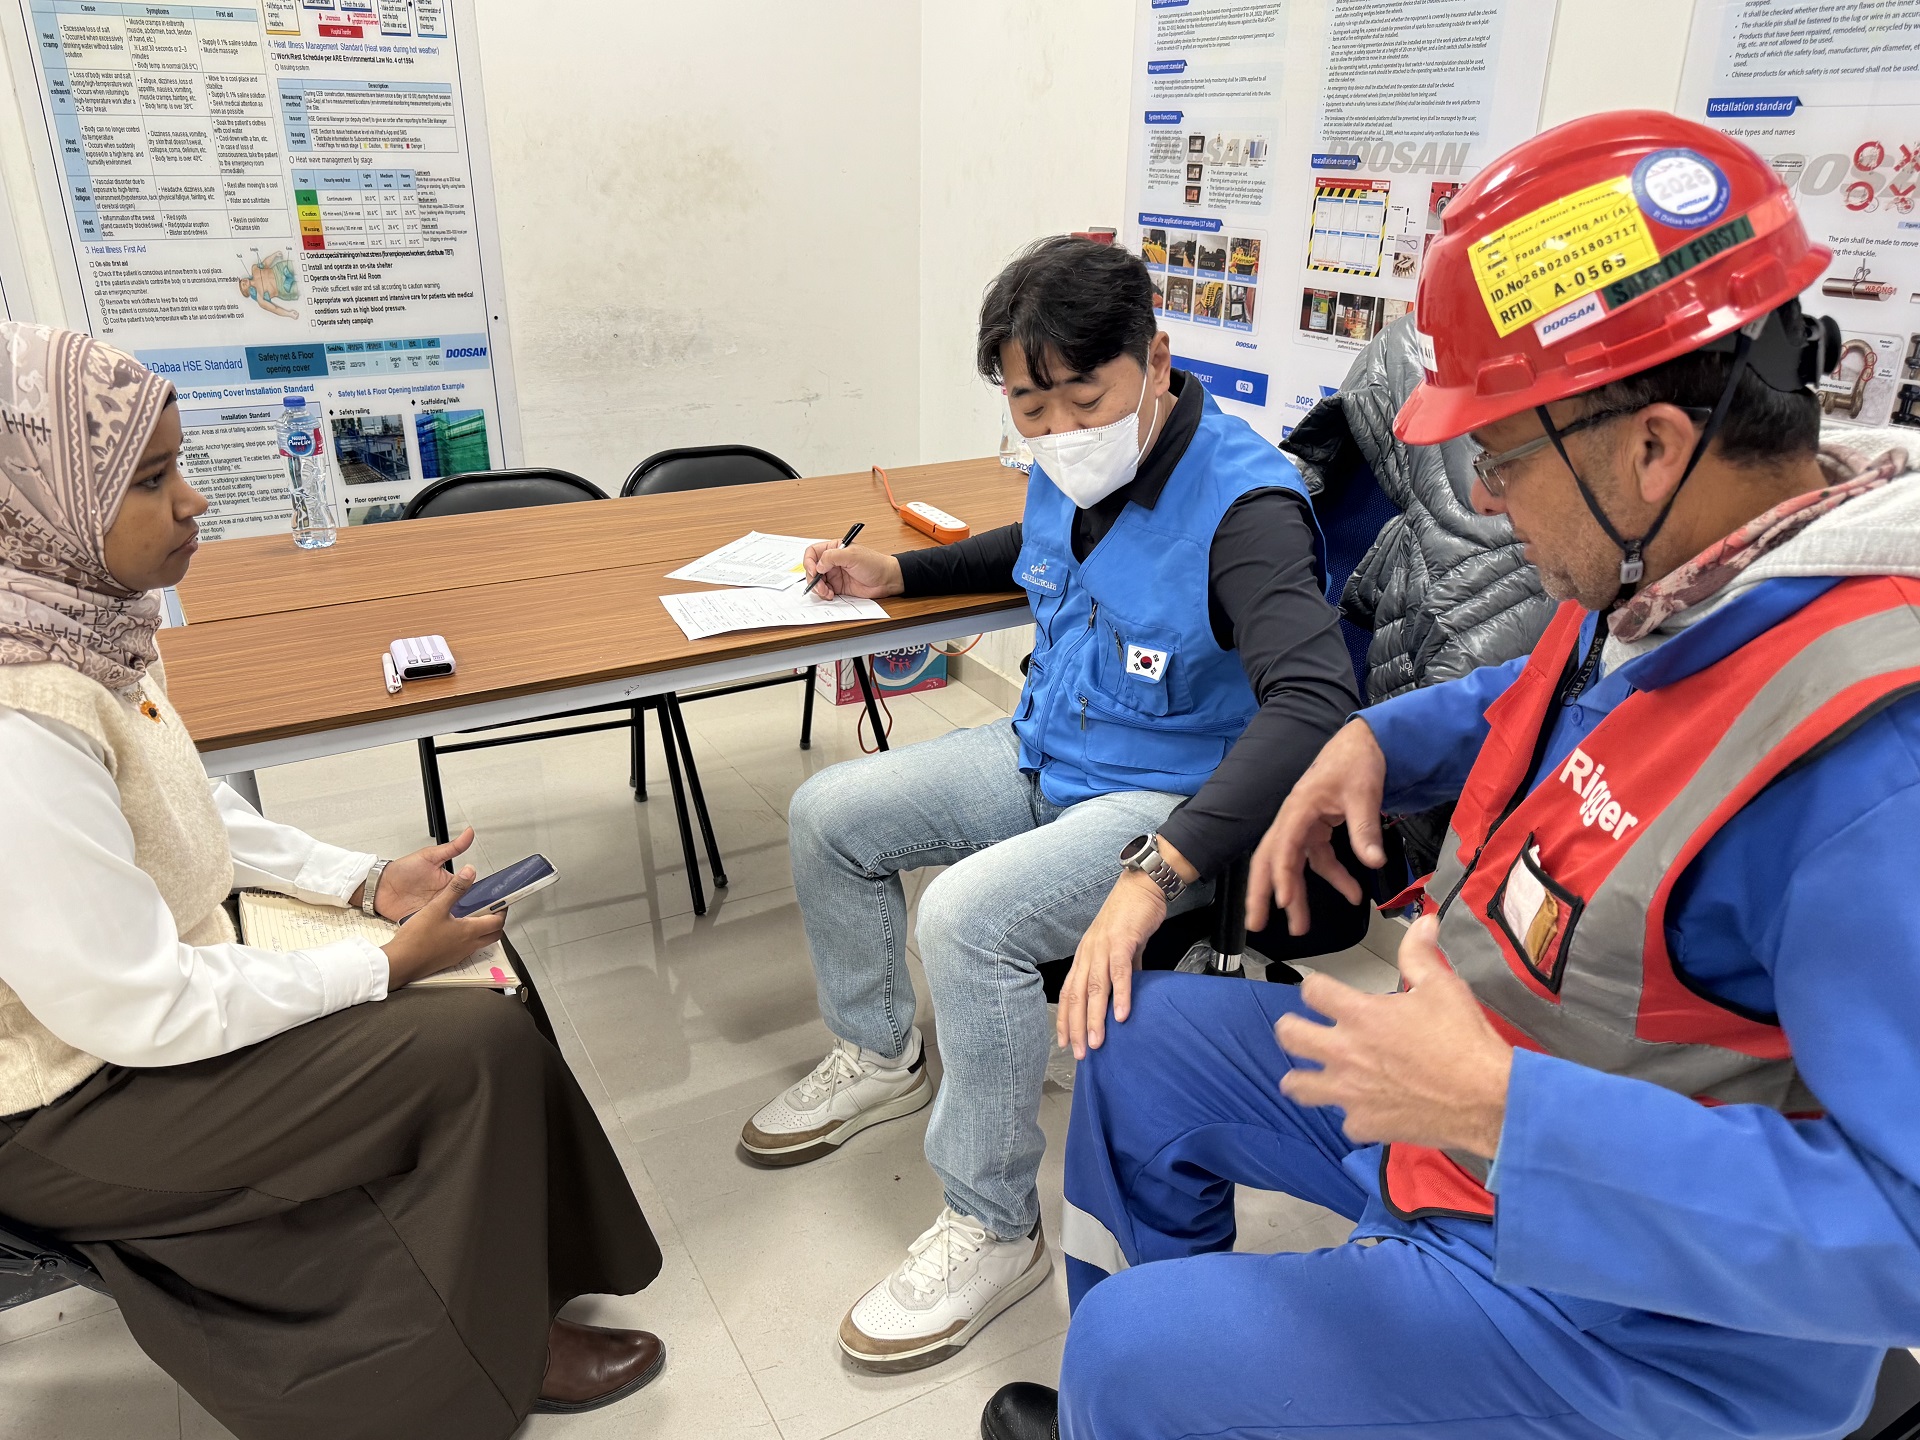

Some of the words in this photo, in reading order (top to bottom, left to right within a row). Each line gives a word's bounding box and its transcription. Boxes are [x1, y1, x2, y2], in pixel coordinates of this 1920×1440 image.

[80, 4, 96, 12] Cause
[146, 8, 170, 16] Symptoms
[1747, 10, 1761, 18] shall
[1769, 7, 1793, 16] checked
[1793, 5, 1818, 14] whether
[1818, 4, 1835, 13] there
[1845, 4, 1858, 12] any
[1858, 1, 1875, 10] flaws
[1884, 0, 1896, 8] the
[43, 41, 59, 49] cramp
[1731, 70, 1752, 78] Chinese
[1752, 69, 1777, 79] products
[1786, 68, 1804, 76] which
[1804, 67, 1823, 77] safety
[1840, 66, 1865, 74] secured
[1864, 65, 1880, 73] shall
[1892, 64, 1901, 72] be
[1709, 101, 1754, 112] Installation
[1755, 100, 1792, 111] standard
[1148, 113, 1160, 122] System
[1720, 128, 1743, 136] Shackle
[1743, 128, 1761, 137] types
[1313, 157, 1336, 166] Installation
[1336, 158, 1355, 168] example
[1327, 140, 1471, 176] DOOSAN
[1653, 168, 1711, 201] 2026
[1142, 215, 1157, 223] Domestic
[1163, 217, 1183, 226] application
[1182, 219, 1200, 228] examples
[1205, 221, 1216, 229] sites)
[1828, 235, 1839, 243] The
[1838, 235, 1850, 245] pin
[1849, 236, 1865, 244] shall
[1864, 237, 1874, 245] be
[1873, 237, 1893, 246] made
[91, 246, 104, 254] Heat
[123, 245, 136, 253] First
[136, 245, 146, 253] Aid
[1831, 247, 1841, 256] ing
[1851, 248, 1877, 257] shackle.
[333, 263, 352, 272] operate
[1490, 278, 1524, 303] ID.No
[1523, 223, 1638, 284] 26802051803717
[1500, 298, 1533, 324] RFID
[1554, 253, 1626, 297] A-0565
[1865, 285, 1897, 296] WRONG!
[317, 318, 336, 327] Operate
[336, 318, 350, 326] safety
[351, 317, 373, 326] campaign
[1542, 302, 1596, 336] DOOSAN
[1235, 340, 1258, 350] DOOSAN
[257, 352, 279, 364] Safety
[279, 351, 290, 361] net
[297, 350, 314, 360] Floor
[446, 347, 487, 358] DOOSAN
[182, 360, 202, 372] HSE
[204, 358, 242, 371] Standard
[266, 363, 291, 375] opening
[176, 390, 190, 400] loor
[191, 388, 222, 401] Opening
[222, 387, 244, 397] Cover
[244, 385, 282, 396] Installation
[283, 383, 314, 393] Standard
[337, 389, 355, 399] Safety
[356, 388, 366, 396] Net
[372, 387, 386, 395] Floor
[387, 385, 411, 396] Opening
[411, 383, 441, 393] Installation
[441, 382, 465, 393] Example
[1239, 382, 1249, 392] 062
[1296, 395, 1314, 407] DOPS
[248, 411, 270, 419] Standard
[339, 408, 354, 417] Safety
[354, 407, 370, 416] railing
[354, 496, 366, 504] Floor
[367, 495, 387, 504] opening
[1559, 748, 1639, 840] Rigger
